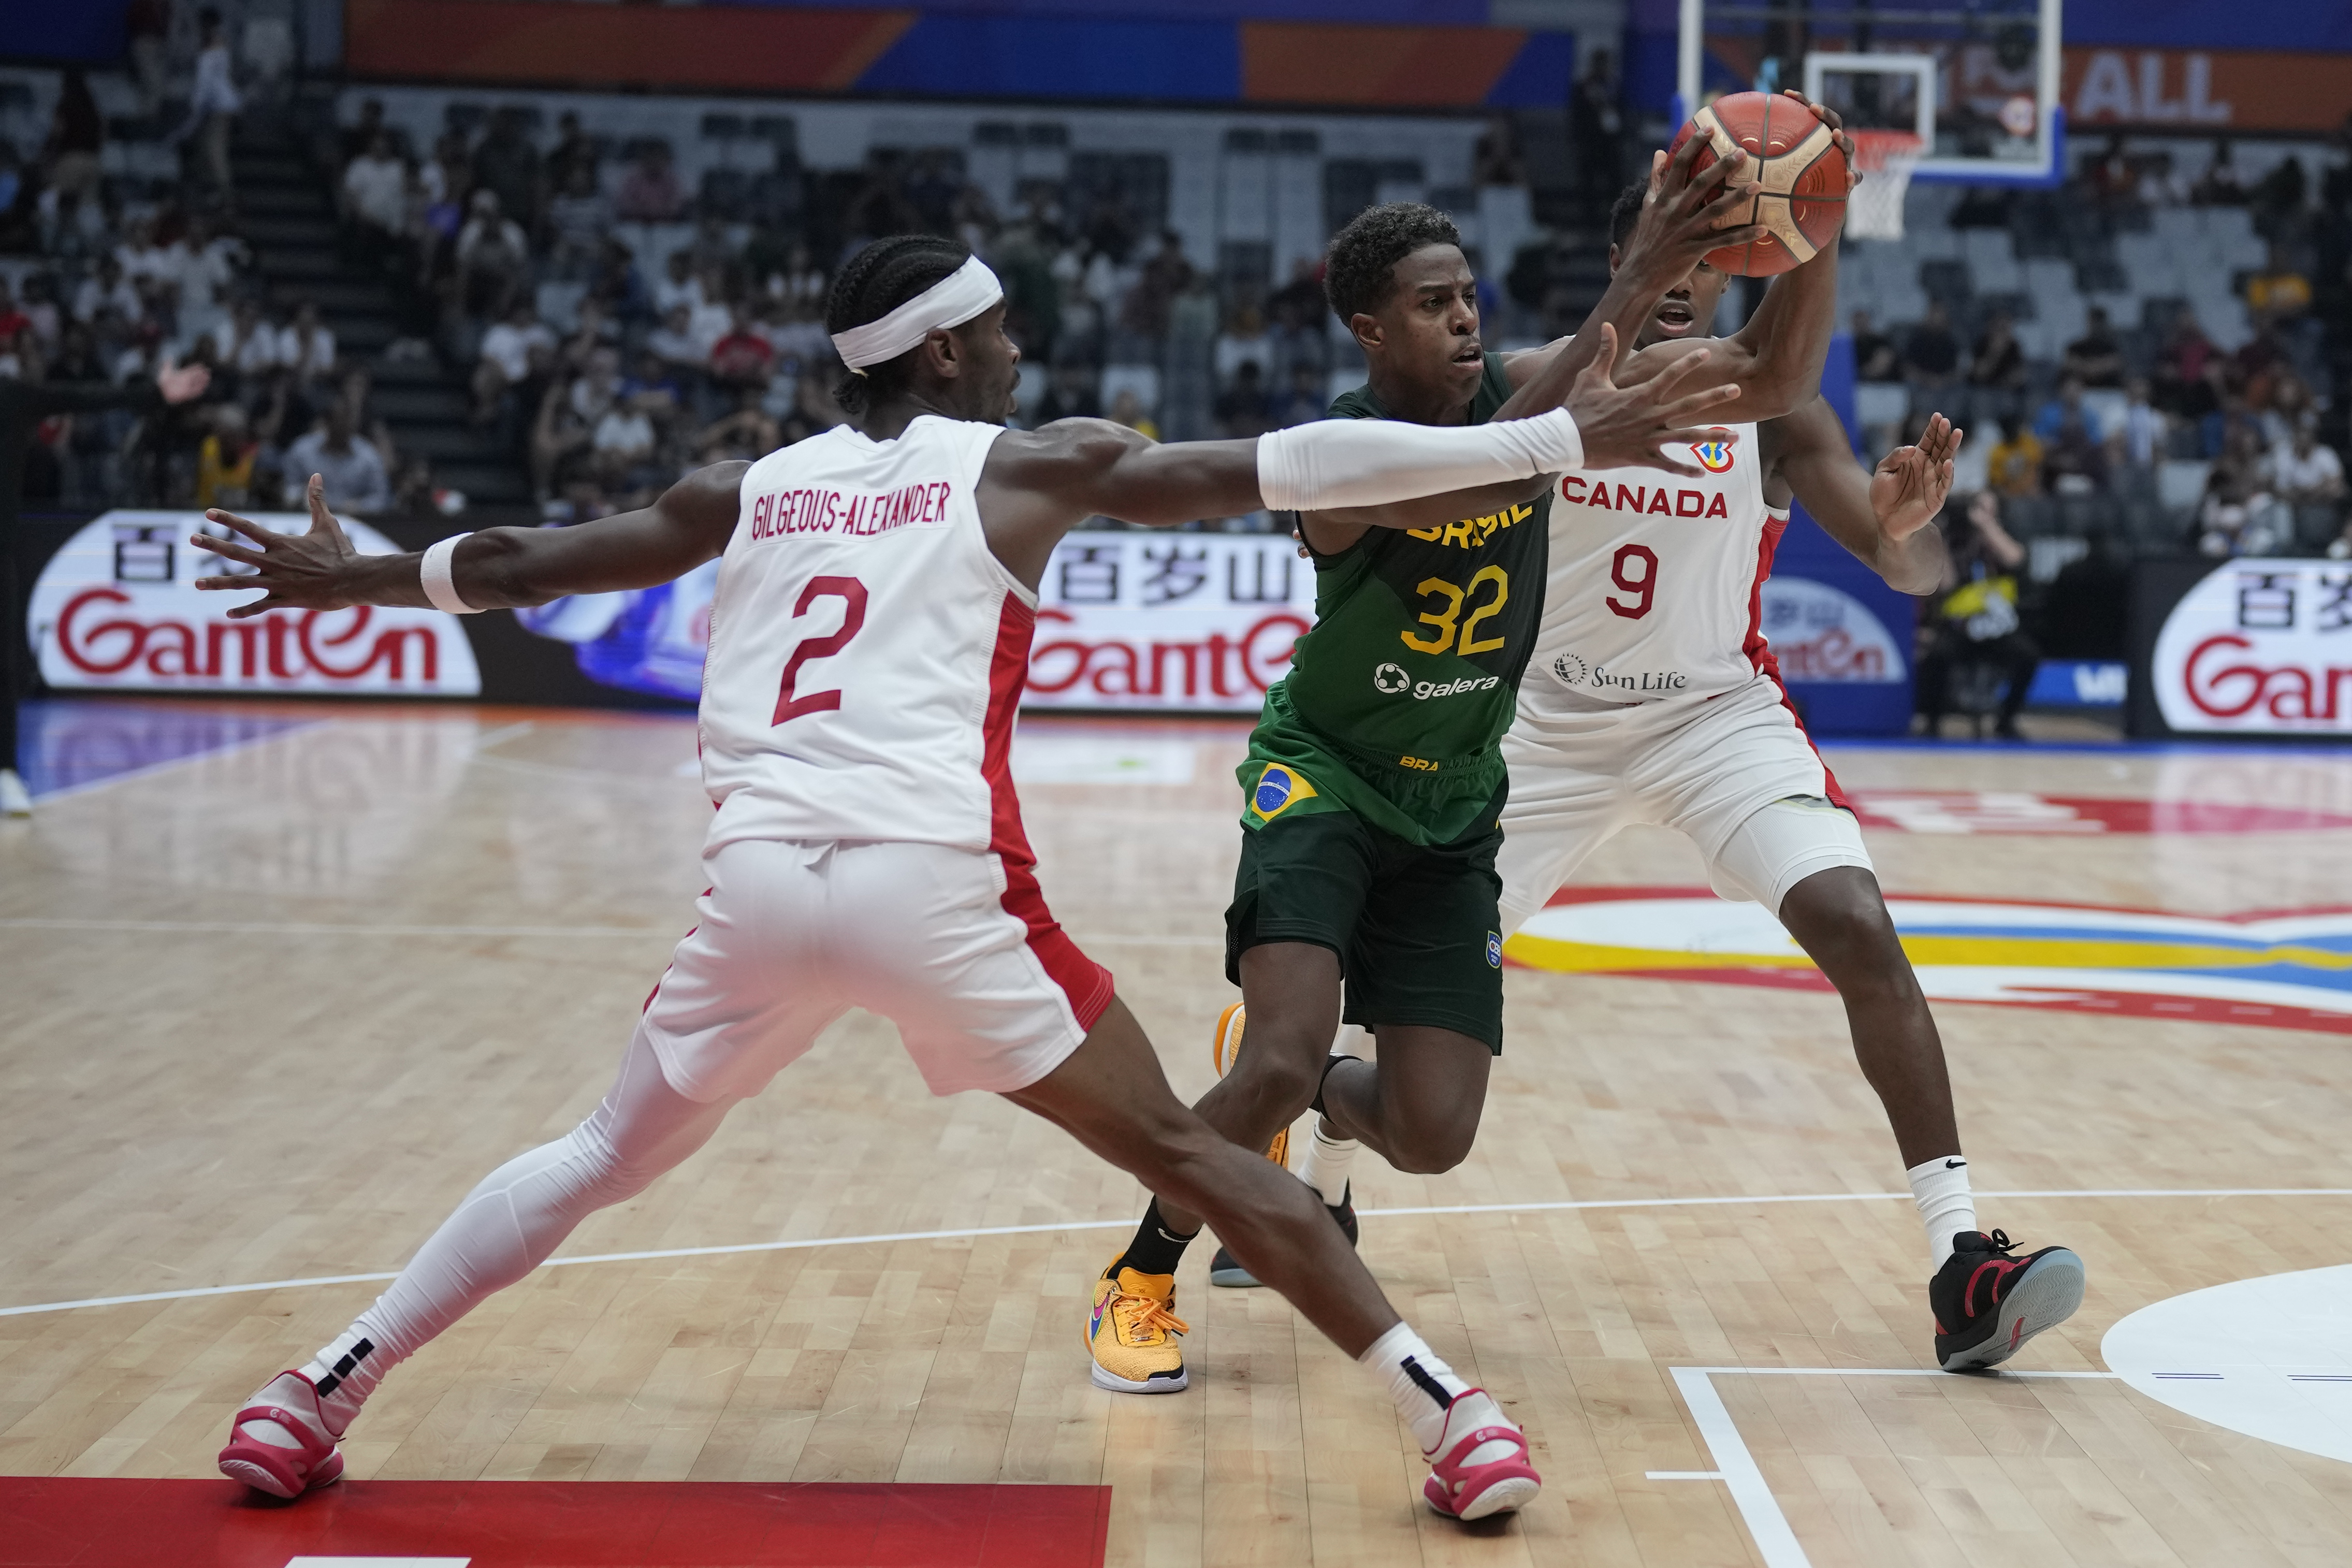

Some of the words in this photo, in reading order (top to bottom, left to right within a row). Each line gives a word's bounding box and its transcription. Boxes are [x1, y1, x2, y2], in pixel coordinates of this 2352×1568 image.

[752, 482, 951, 541] GILGEOUS-ALEXANDER
[1562, 476, 1727, 518] CANADA
[1057, 540, 1293, 606] 百岁山
[1606, 544, 1658, 620] 9
[57, 589, 439, 680] Ganten
[1401, 564, 1508, 656] 32
[771, 576, 868, 727] 2
[1026, 609, 1311, 698] Gante
[1592, 667, 1635, 690] Sun
[1641, 672, 1686, 690] Life
[1413, 676, 1499, 700] galera
[1399, 756, 1439, 772] BRA
